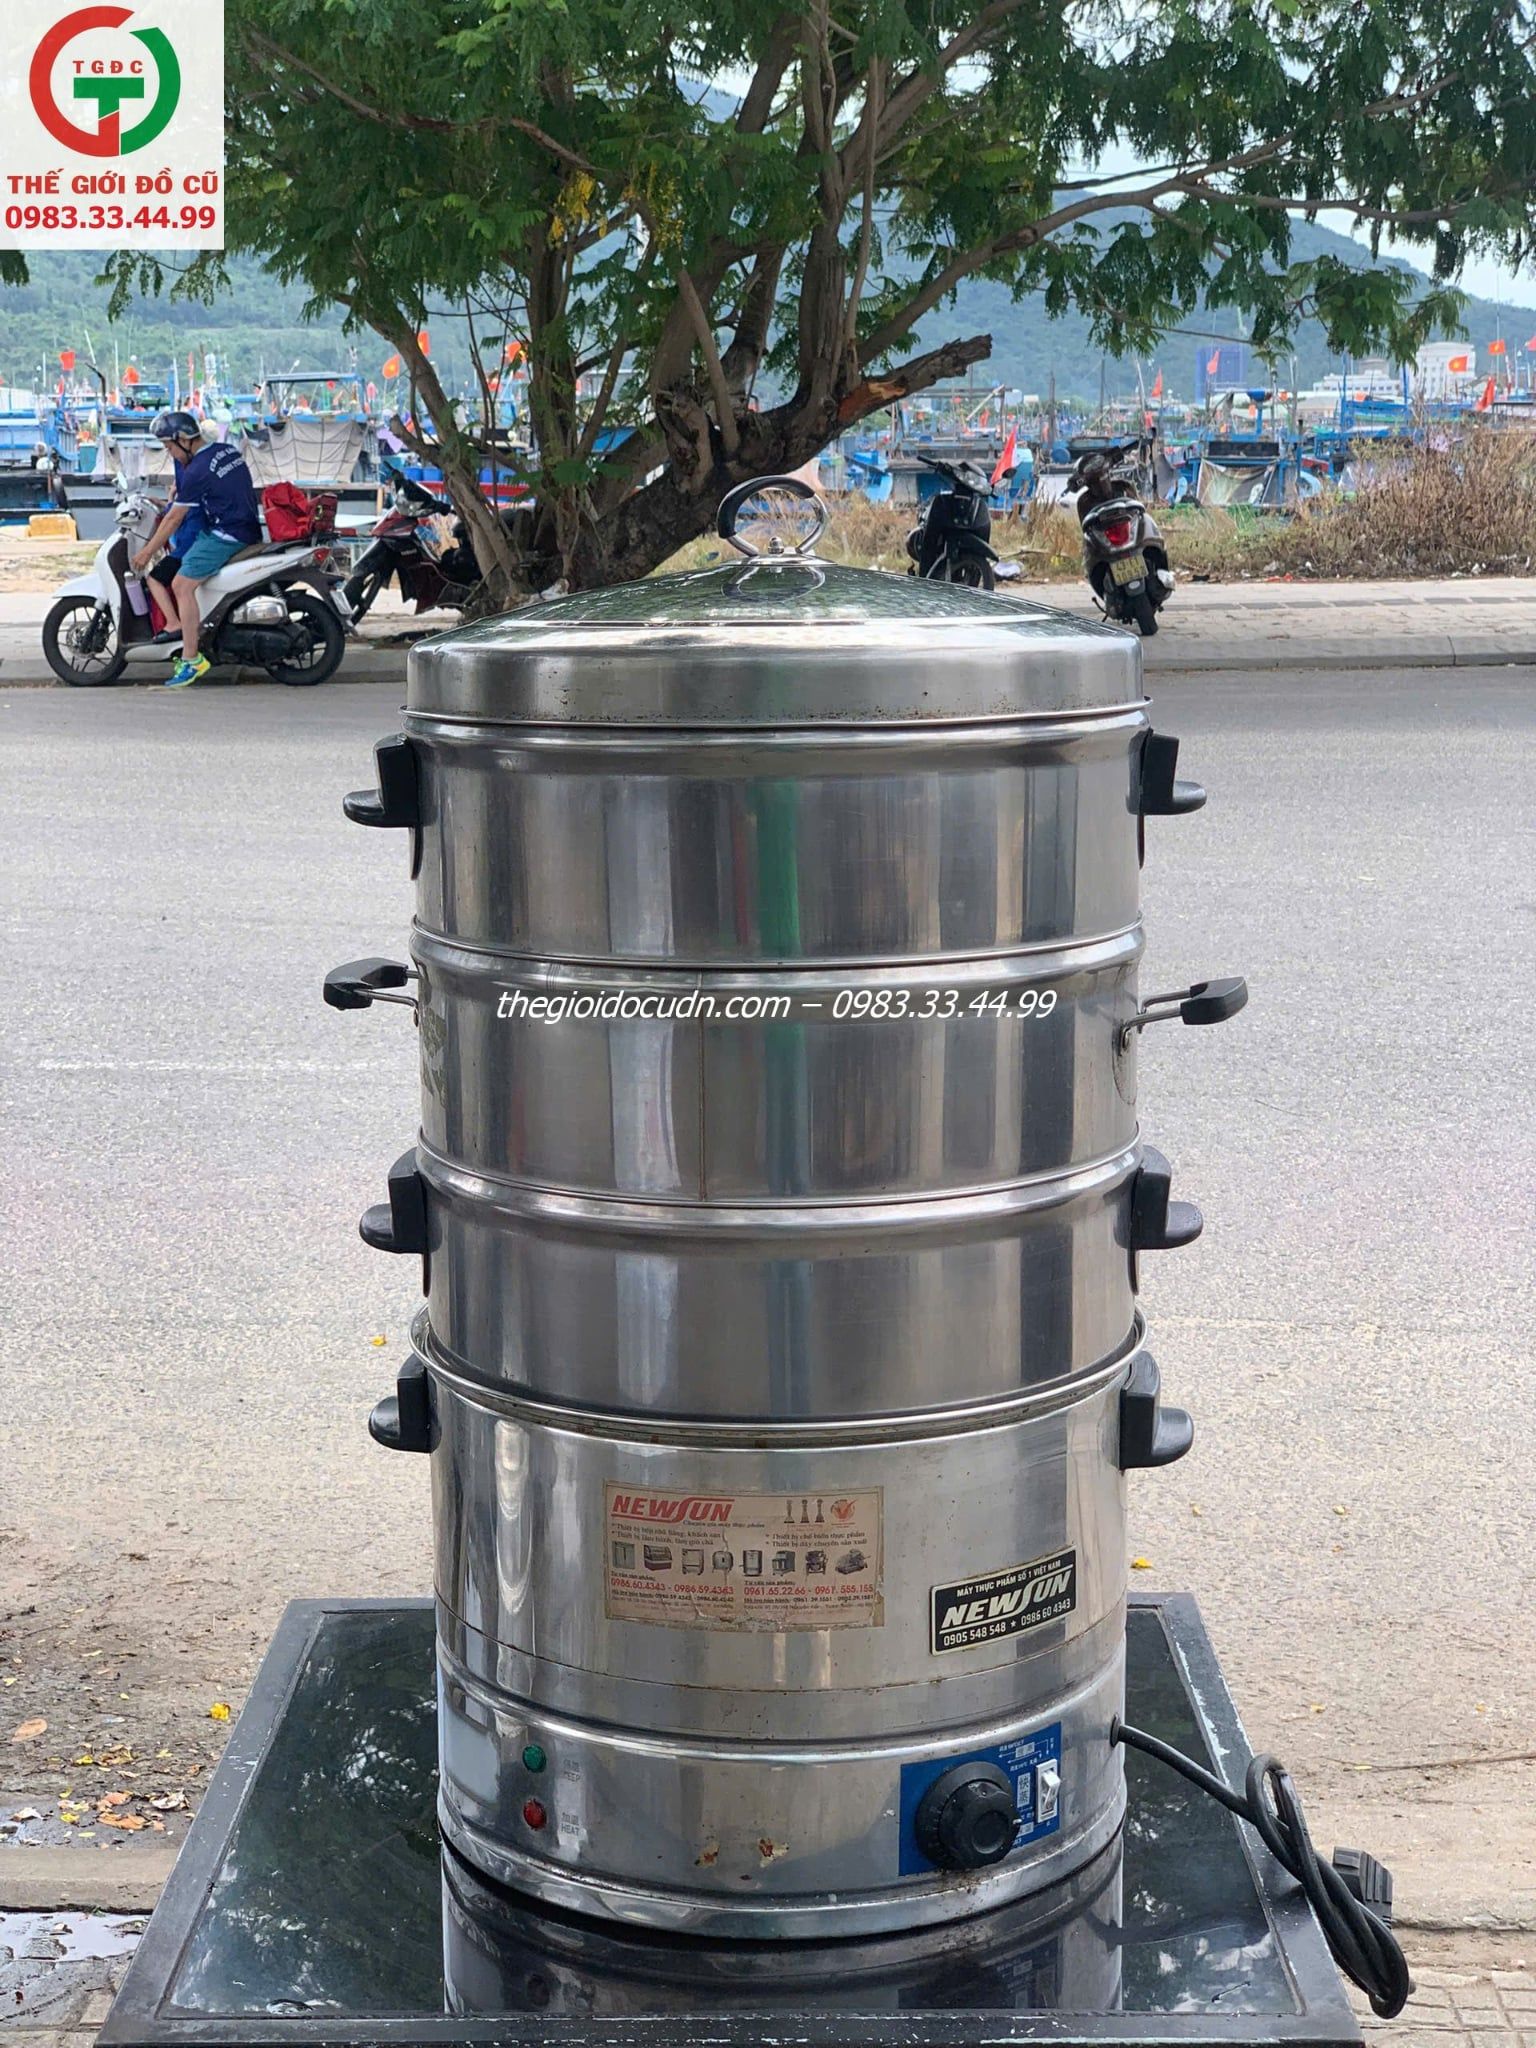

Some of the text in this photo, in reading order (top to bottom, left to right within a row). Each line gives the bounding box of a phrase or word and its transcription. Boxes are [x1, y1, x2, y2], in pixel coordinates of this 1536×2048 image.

[743, 1586, 806, 1596] 0961.65.22.66
[956, 1585, 974, 1597] MÁY
[975, 1581, 995, 1593] THỰC
[996, 1573, 1017, 1588] PHẨM
[1017, 1569, 1027, 1582] SỐ
[1033, 1564, 1047, 1577] VIỆT
[1047, 1560, 1061, 1570] NAM
[940, 1565, 1073, 1634] NEWSUN
[943, 1598, 1071, 1646] 0905 548 548 0986 60 4343
[561, 1823, 579, 1836] HEAT
